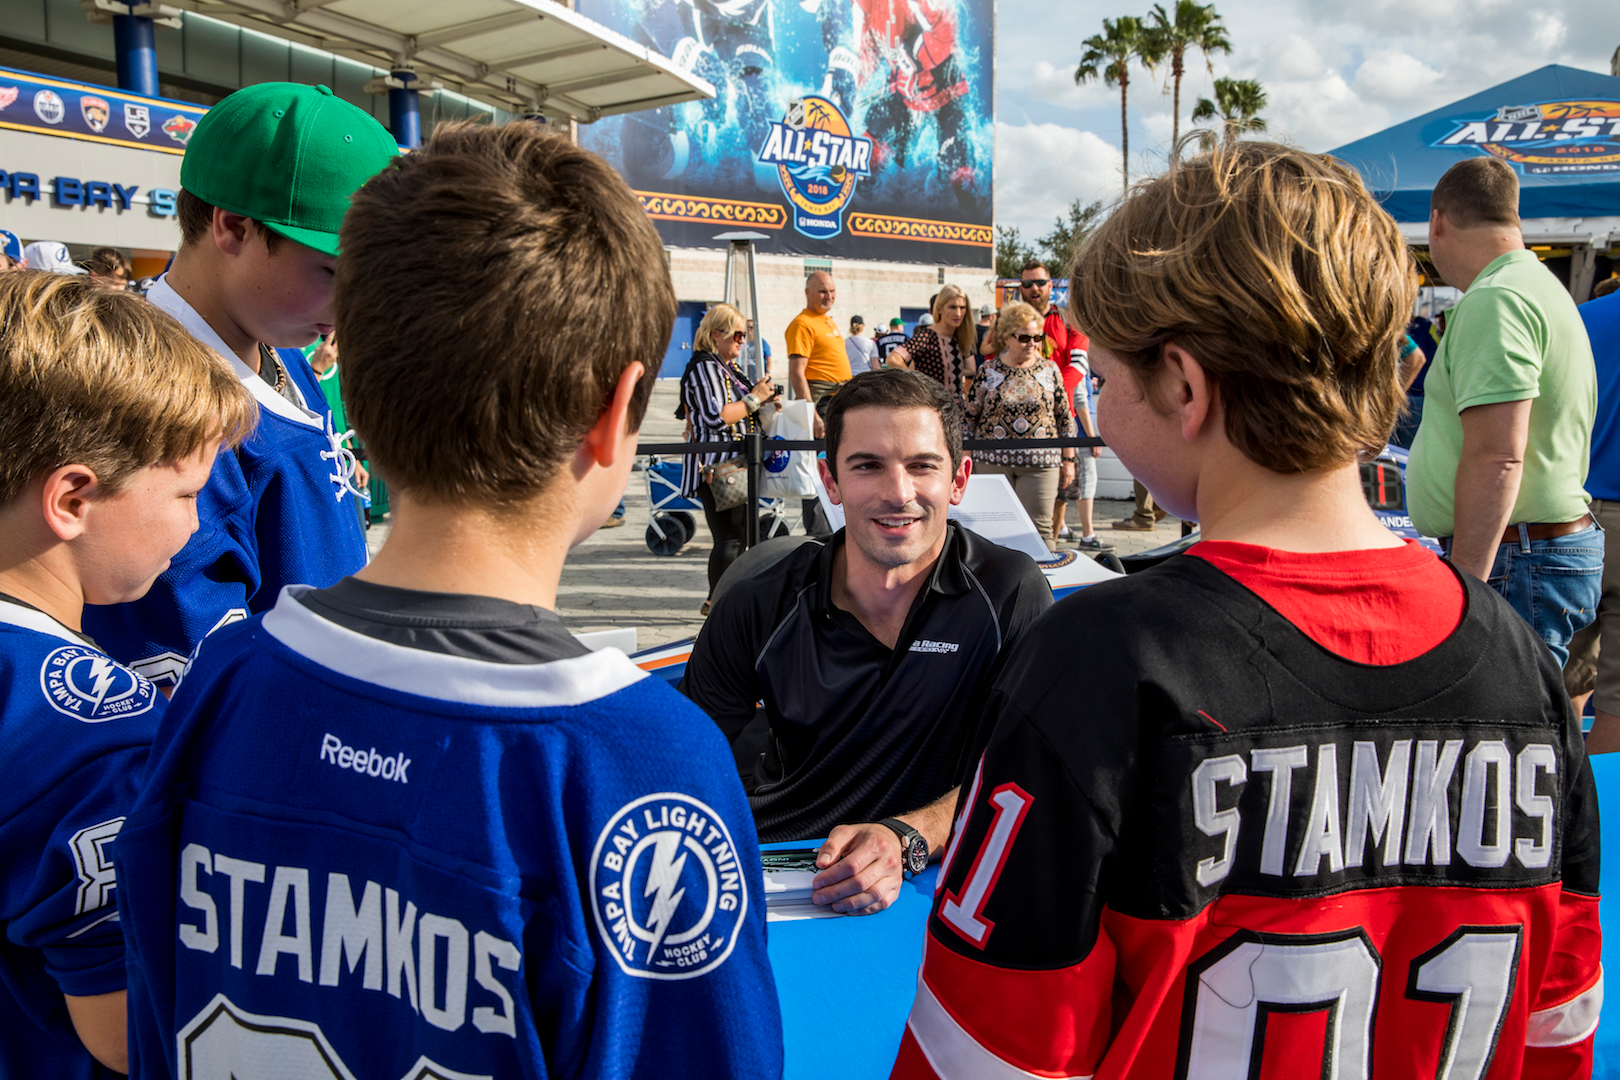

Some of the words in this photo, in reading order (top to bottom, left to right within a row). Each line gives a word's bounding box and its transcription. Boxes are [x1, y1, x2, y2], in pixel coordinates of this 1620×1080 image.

[54, 176, 139, 210] BAY
[807, 184, 828, 195] 2018
[800, 200, 822, 212] TAMPA
[825, 203, 836, 212] BAY
[807, 218, 837, 228] HONDA
[1377, 516, 1414, 528] ANDE
[921, 639, 960, 653] Racing
[52, 649, 79, 667] BAY
[49, 669, 82, 711] TAMPA
[103, 697, 135, 711] HOCKEY
[112, 705, 133, 714] CLUB
[320, 733, 411, 784] Reebok
[1192, 739, 1556, 888] STAMKOS
[603, 818, 639, 873] BAY
[643, 806, 740, 911] LIGHTNING
[602, 881, 637, 961] TAMPA
[179, 843, 521, 1039] STAMKOS
[664, 933, 711, 958] HOCKEY
[677, 949, 708, 967] CLUB
